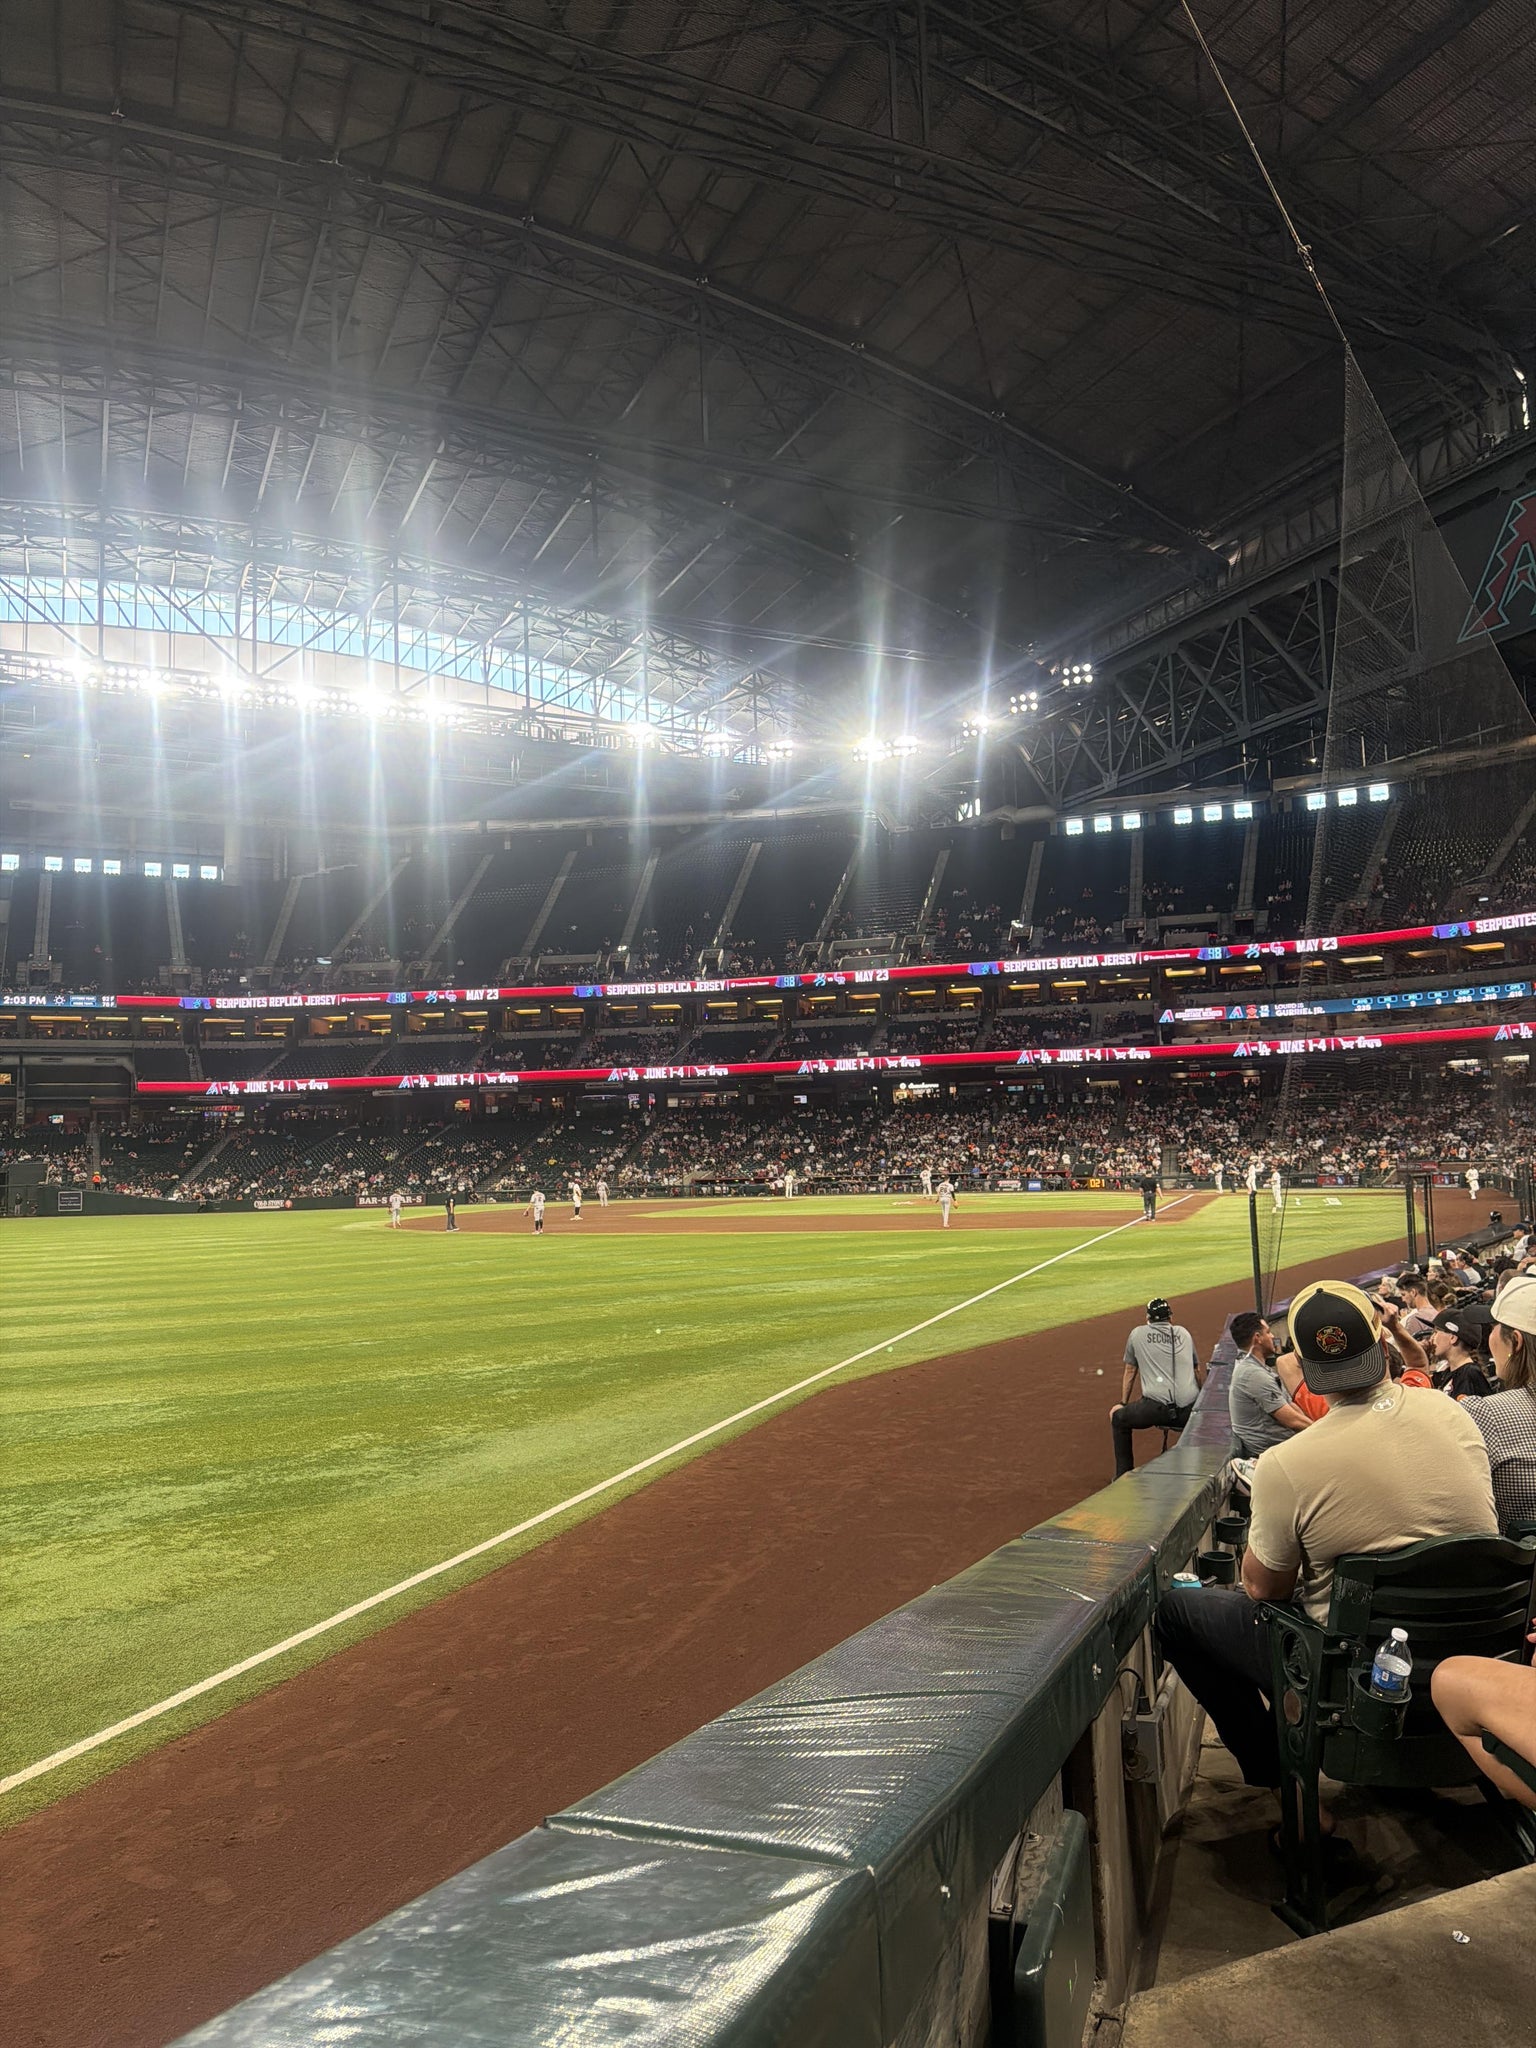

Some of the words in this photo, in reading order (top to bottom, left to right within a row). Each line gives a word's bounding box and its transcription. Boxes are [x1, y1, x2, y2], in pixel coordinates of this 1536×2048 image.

[1296, 939, 1319, 953] MAY
[1322, 937, 1338, 951] 23
[1004, 957, 1058, 972] SERPIENTES
[1060, 955, 1099, 969] REPLICA
[1101, 953, 1137, 967] JERSEY
[855, 970, 874, 982] MAY
[876, 969, 889, 981] 23
[466, 989, 484, 1001] MAY
[487, 988, 499, 1000] 23
[606, 983, 656, 996] SERPIENTES
[657, 982, 691, 994] REPLICA
[693, 980, 726, 992] JERSEY
[3, 996, 26, 1005] 2:03
[29, 996, 46, 1005] PM
[215, 997, 268, 1009] SERPIENTES
[269, 996, 303, 1007] REPLICA
[304, 994, 336, 1006] JERSEY
[1277, 1040, 1304, 1054] JUNE
[1307, 1039, 1326, 1052] 1-4
[1057, 1049, 1082, 1062] JUNE
[1085, 1048, 1101, 1061] 1-4
[833, 1059, 857, 1071] JUNE
[860, 1058, 874, 1069] 1-4
[643, 1068, 667, 1079] JUNE
[670, 1067, 684, 1078] 1-4
[244, 1081, 267, 1093] JUNE
[270, 1080, 284, 1092] 1-4
[434, 1075, 457, 1086] JUNE
[460, 1074, 474, 1085] 1-4
[359, 1196, 387, 1205] BAR-S
[1147, 1332, 1182, 1346] SECURTY
